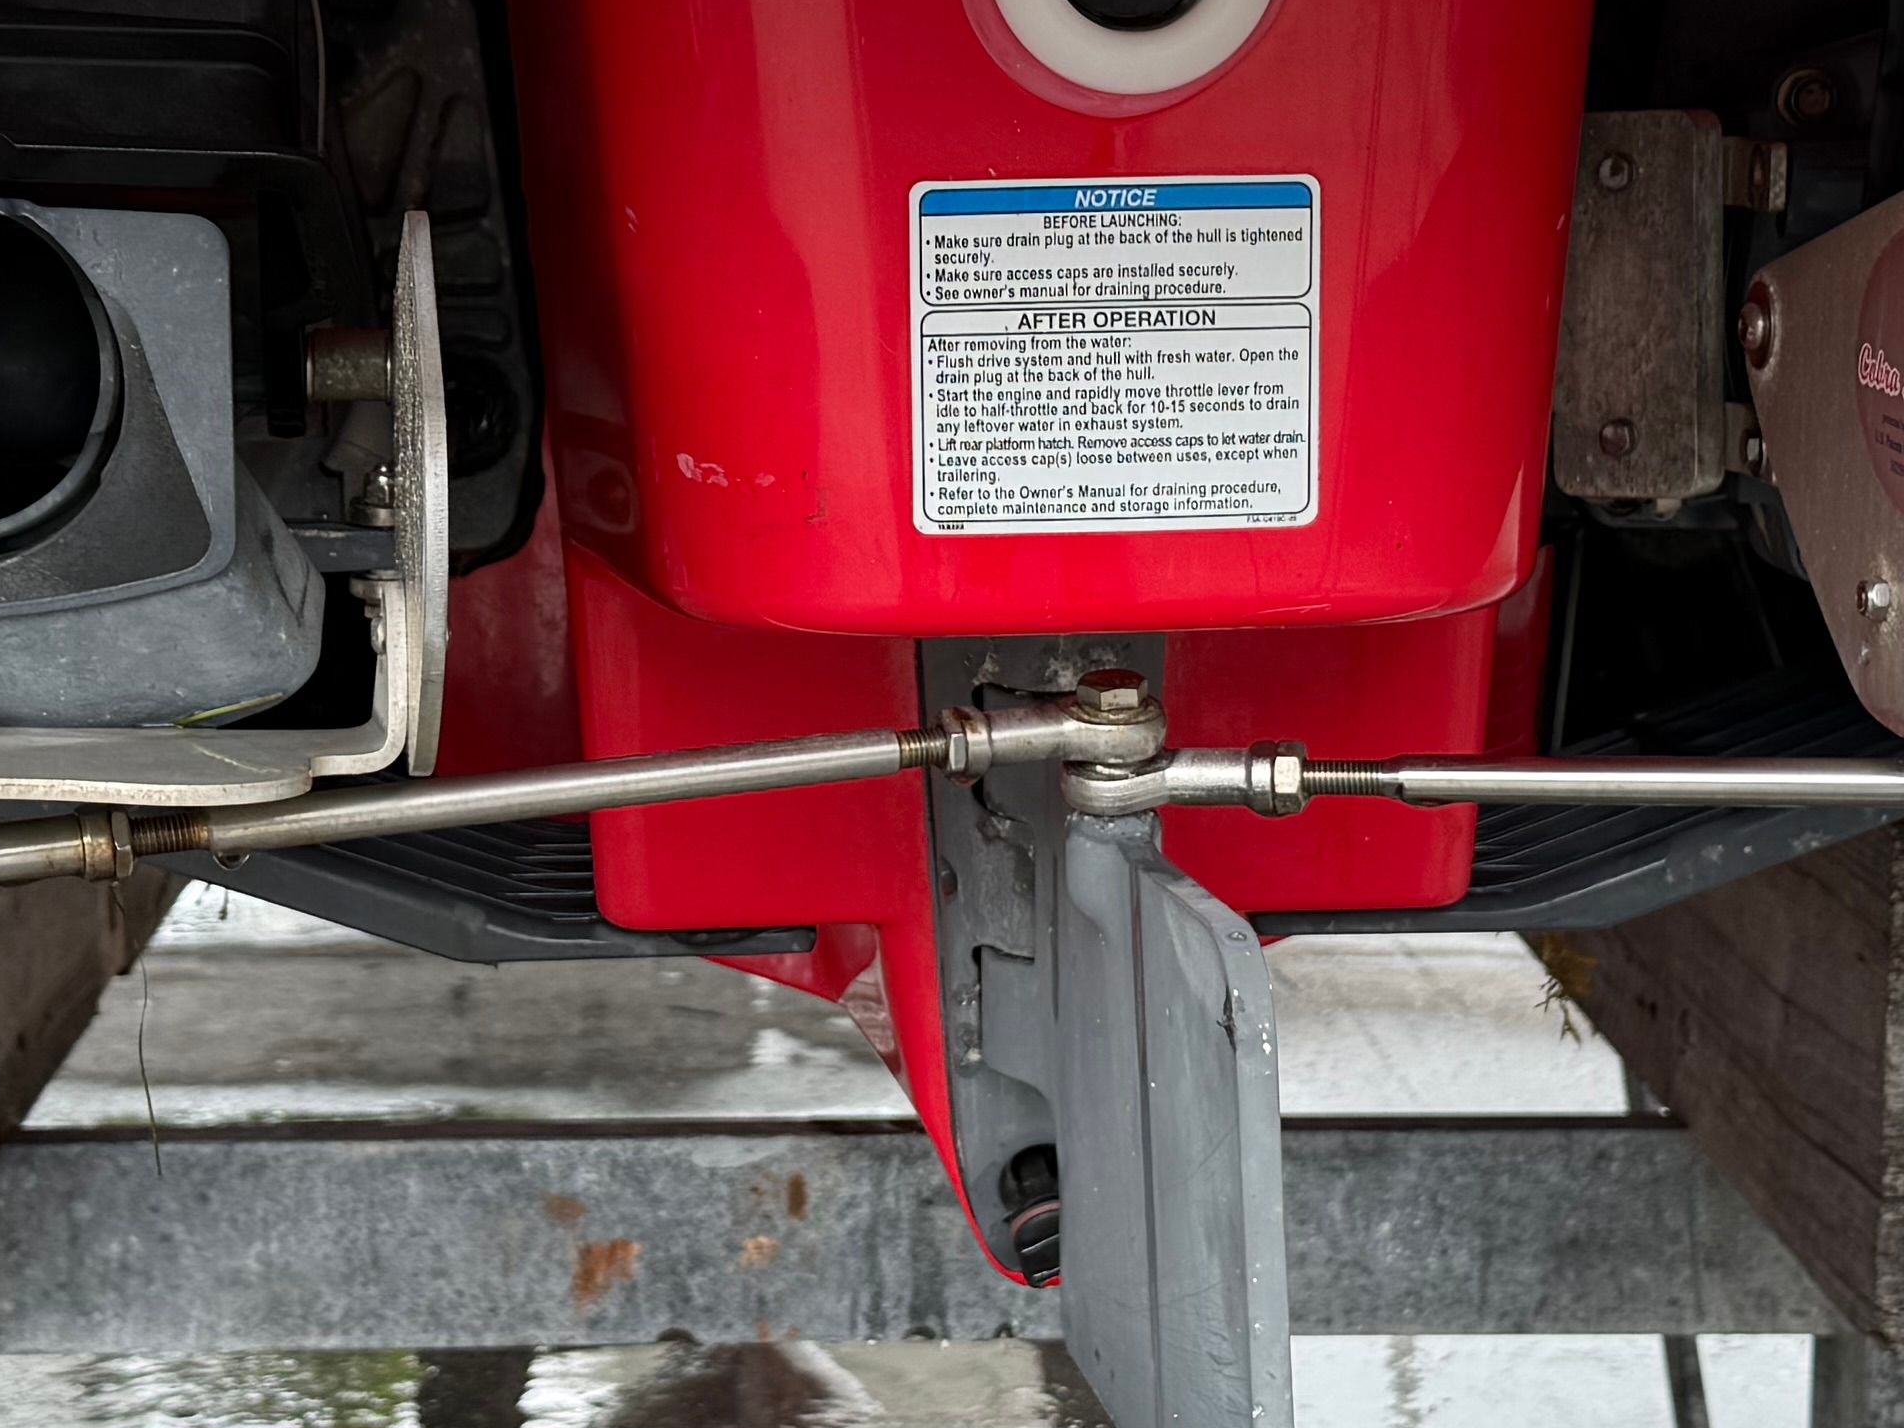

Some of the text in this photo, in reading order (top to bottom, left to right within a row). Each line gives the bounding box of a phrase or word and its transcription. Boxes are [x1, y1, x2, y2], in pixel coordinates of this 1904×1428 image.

[1075, 189, 1157, 207] NOTICE
[1043, 214, 1182, 230] BEFORE LAUNCHING:
[934, 227, 1303, 249] Make sure drain plug at the back of the hull is tightened
[934, 249, 994, 267] securely.
[935, 262, 1238, 283] Make sure access caps are installed securely.
[935, 280, 1226, 300] See owner's manual for draining procedure.
[1018, 309, 1216, 330] AFTER OPERATION
[927, 334, 1131, 354] After removing from the water:
[937, 347, 1299, 370] Flush drive system and hull with fresh water. Open the
[936, 366, 1155, 387] drain plug at the back of the hull.
[1858, 343, 1900, 397] Cobra
[937, 381, 1284, 404] Start the engine and rapidly move throttle lever from
[936, 396, 1299, 417] idle to half-throttle and back for 10-15 seconds to drain
[936, 415, 1183, 437] any leftover water in exhaust system.
[938, 429, 1306, 453] Lift rear platform hatch. Remove access caps to let water drain.
[938, 445, 1298, 468] Leave access cap(s) loose between uses, except when
[937, 468, 1000, 487] trailering.
[939, 479, 1281, 500] Refer to the Owner's Manual for draining procedure,
[938, 496, 1253, 519] complete maintenance and storage information.
